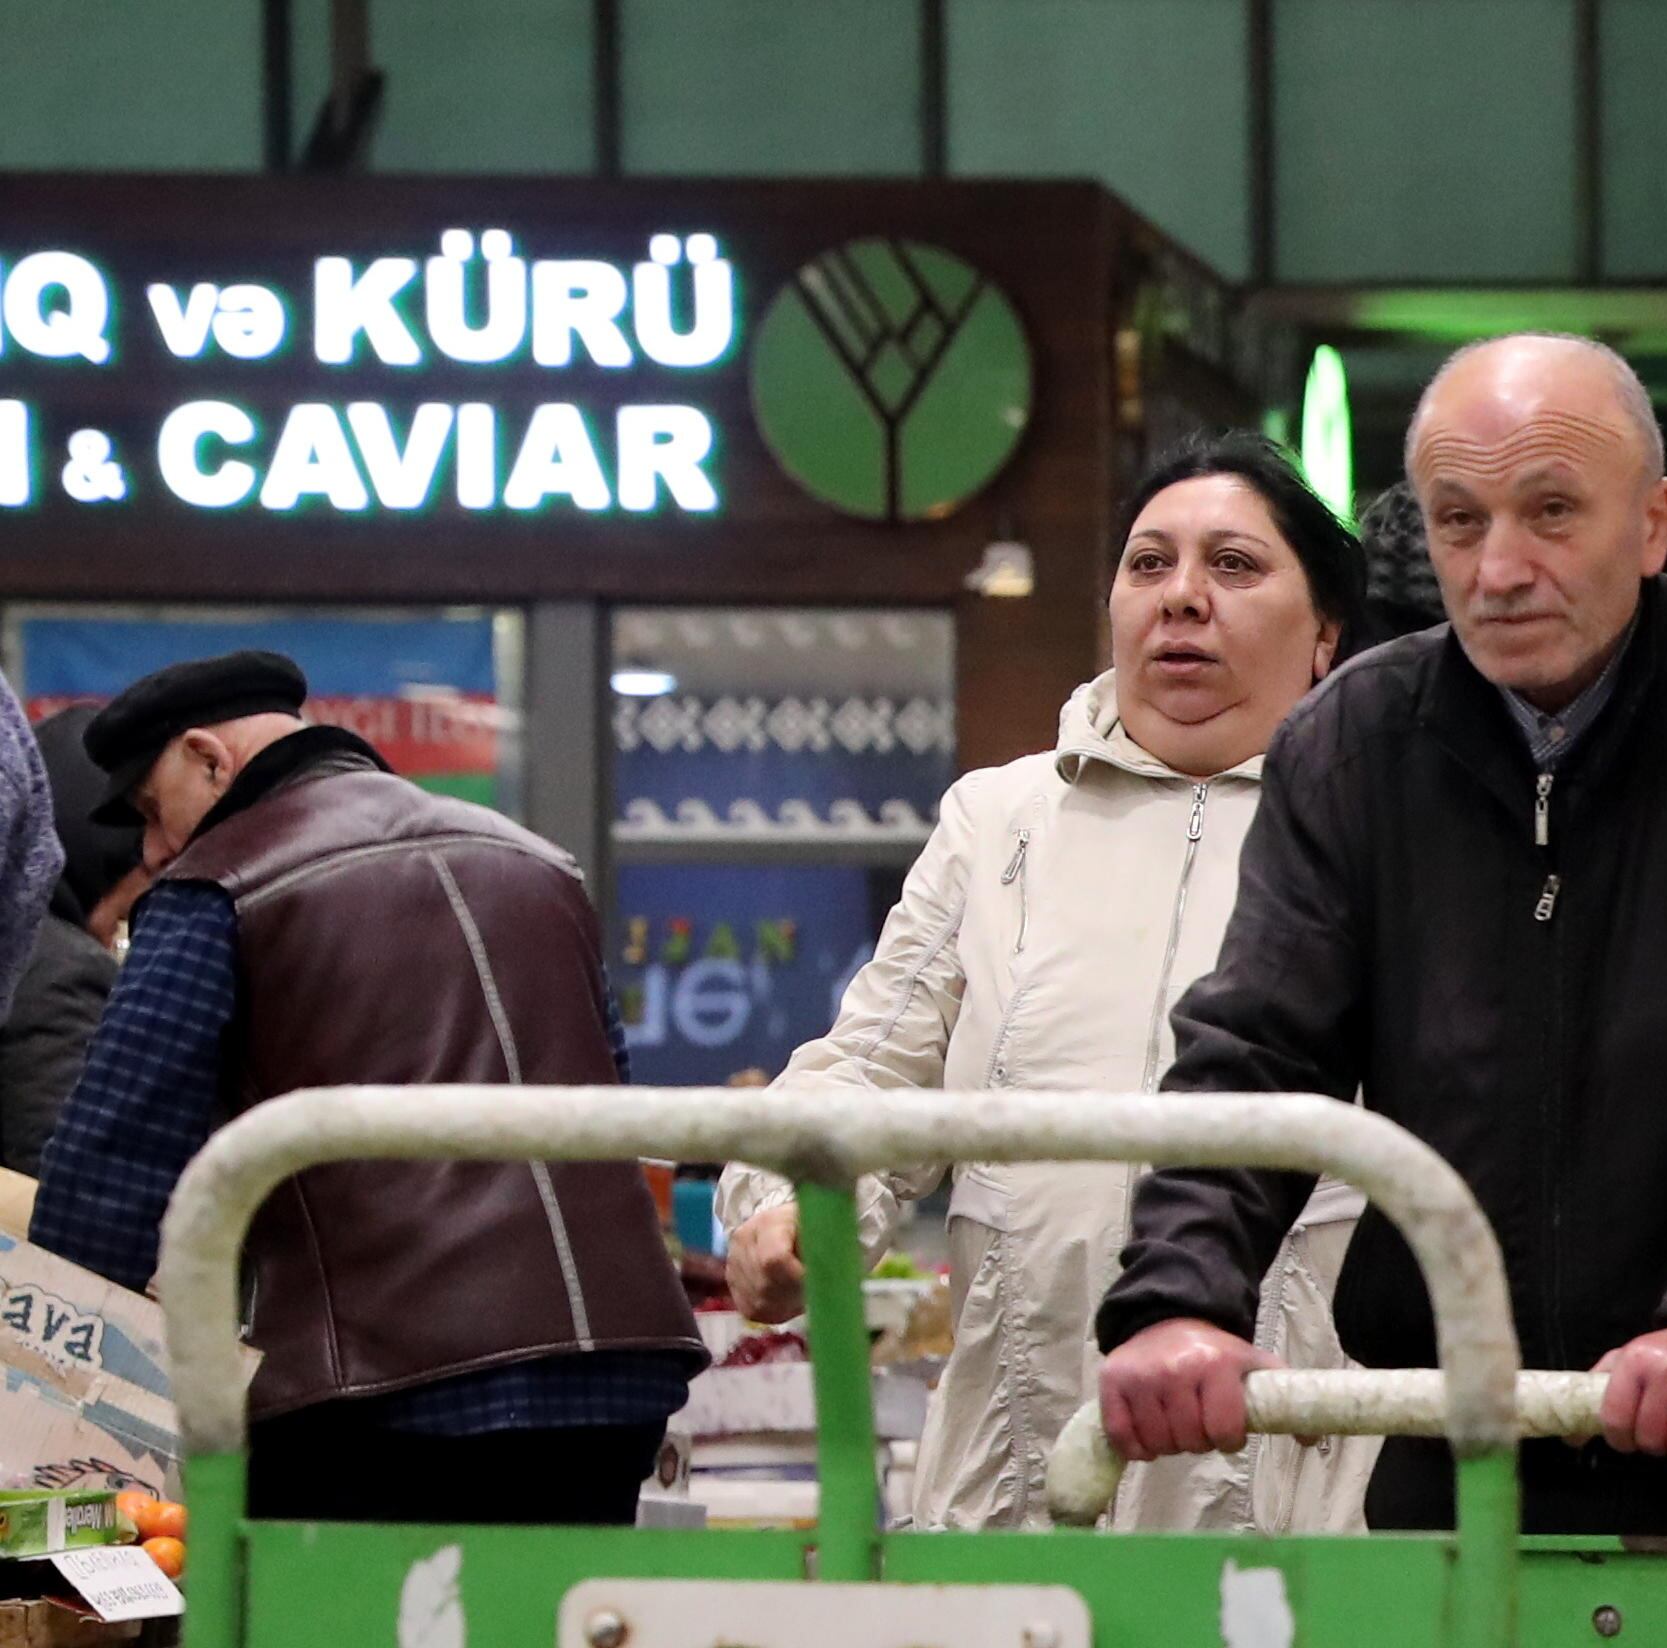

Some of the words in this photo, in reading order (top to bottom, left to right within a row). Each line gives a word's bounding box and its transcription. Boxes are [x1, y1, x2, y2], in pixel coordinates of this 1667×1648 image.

[0, 251, 109, 363] Q
[147, 281, 285, 360] və
[313, 228, 733, 369] KÜRÜ
[61, 427, 126, 503] &
[157, 399, 720, 512] CAVIAR
